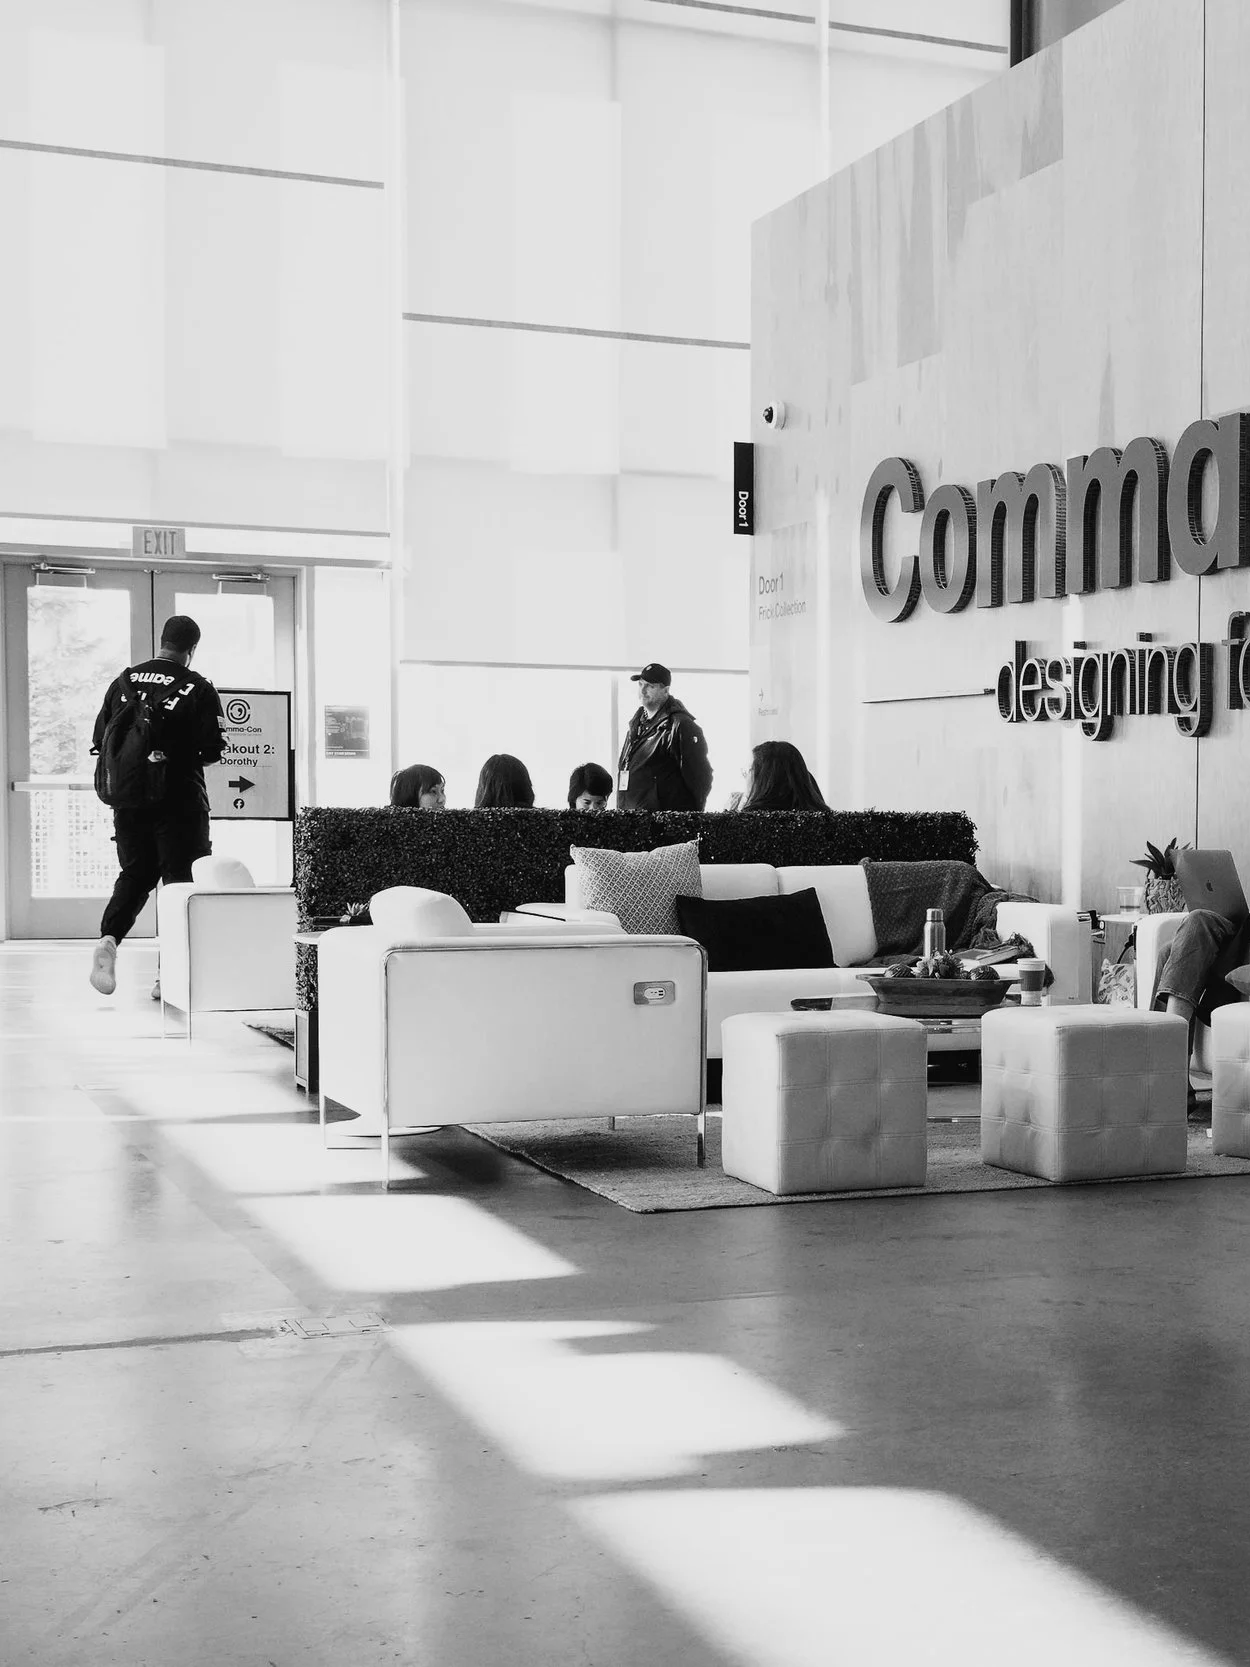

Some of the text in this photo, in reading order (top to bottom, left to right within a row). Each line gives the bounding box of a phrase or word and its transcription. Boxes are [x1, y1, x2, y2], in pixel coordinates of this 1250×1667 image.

[738, 491, 750, 520] Door
[144, 529, 179, 556] EXIT
[758, 572, 784, 595] Door 1
[997, 632, 1213, 742] designing
[226, 744, 275, 754] akout 2:
[220, 757, 258, 767] Dorothy
